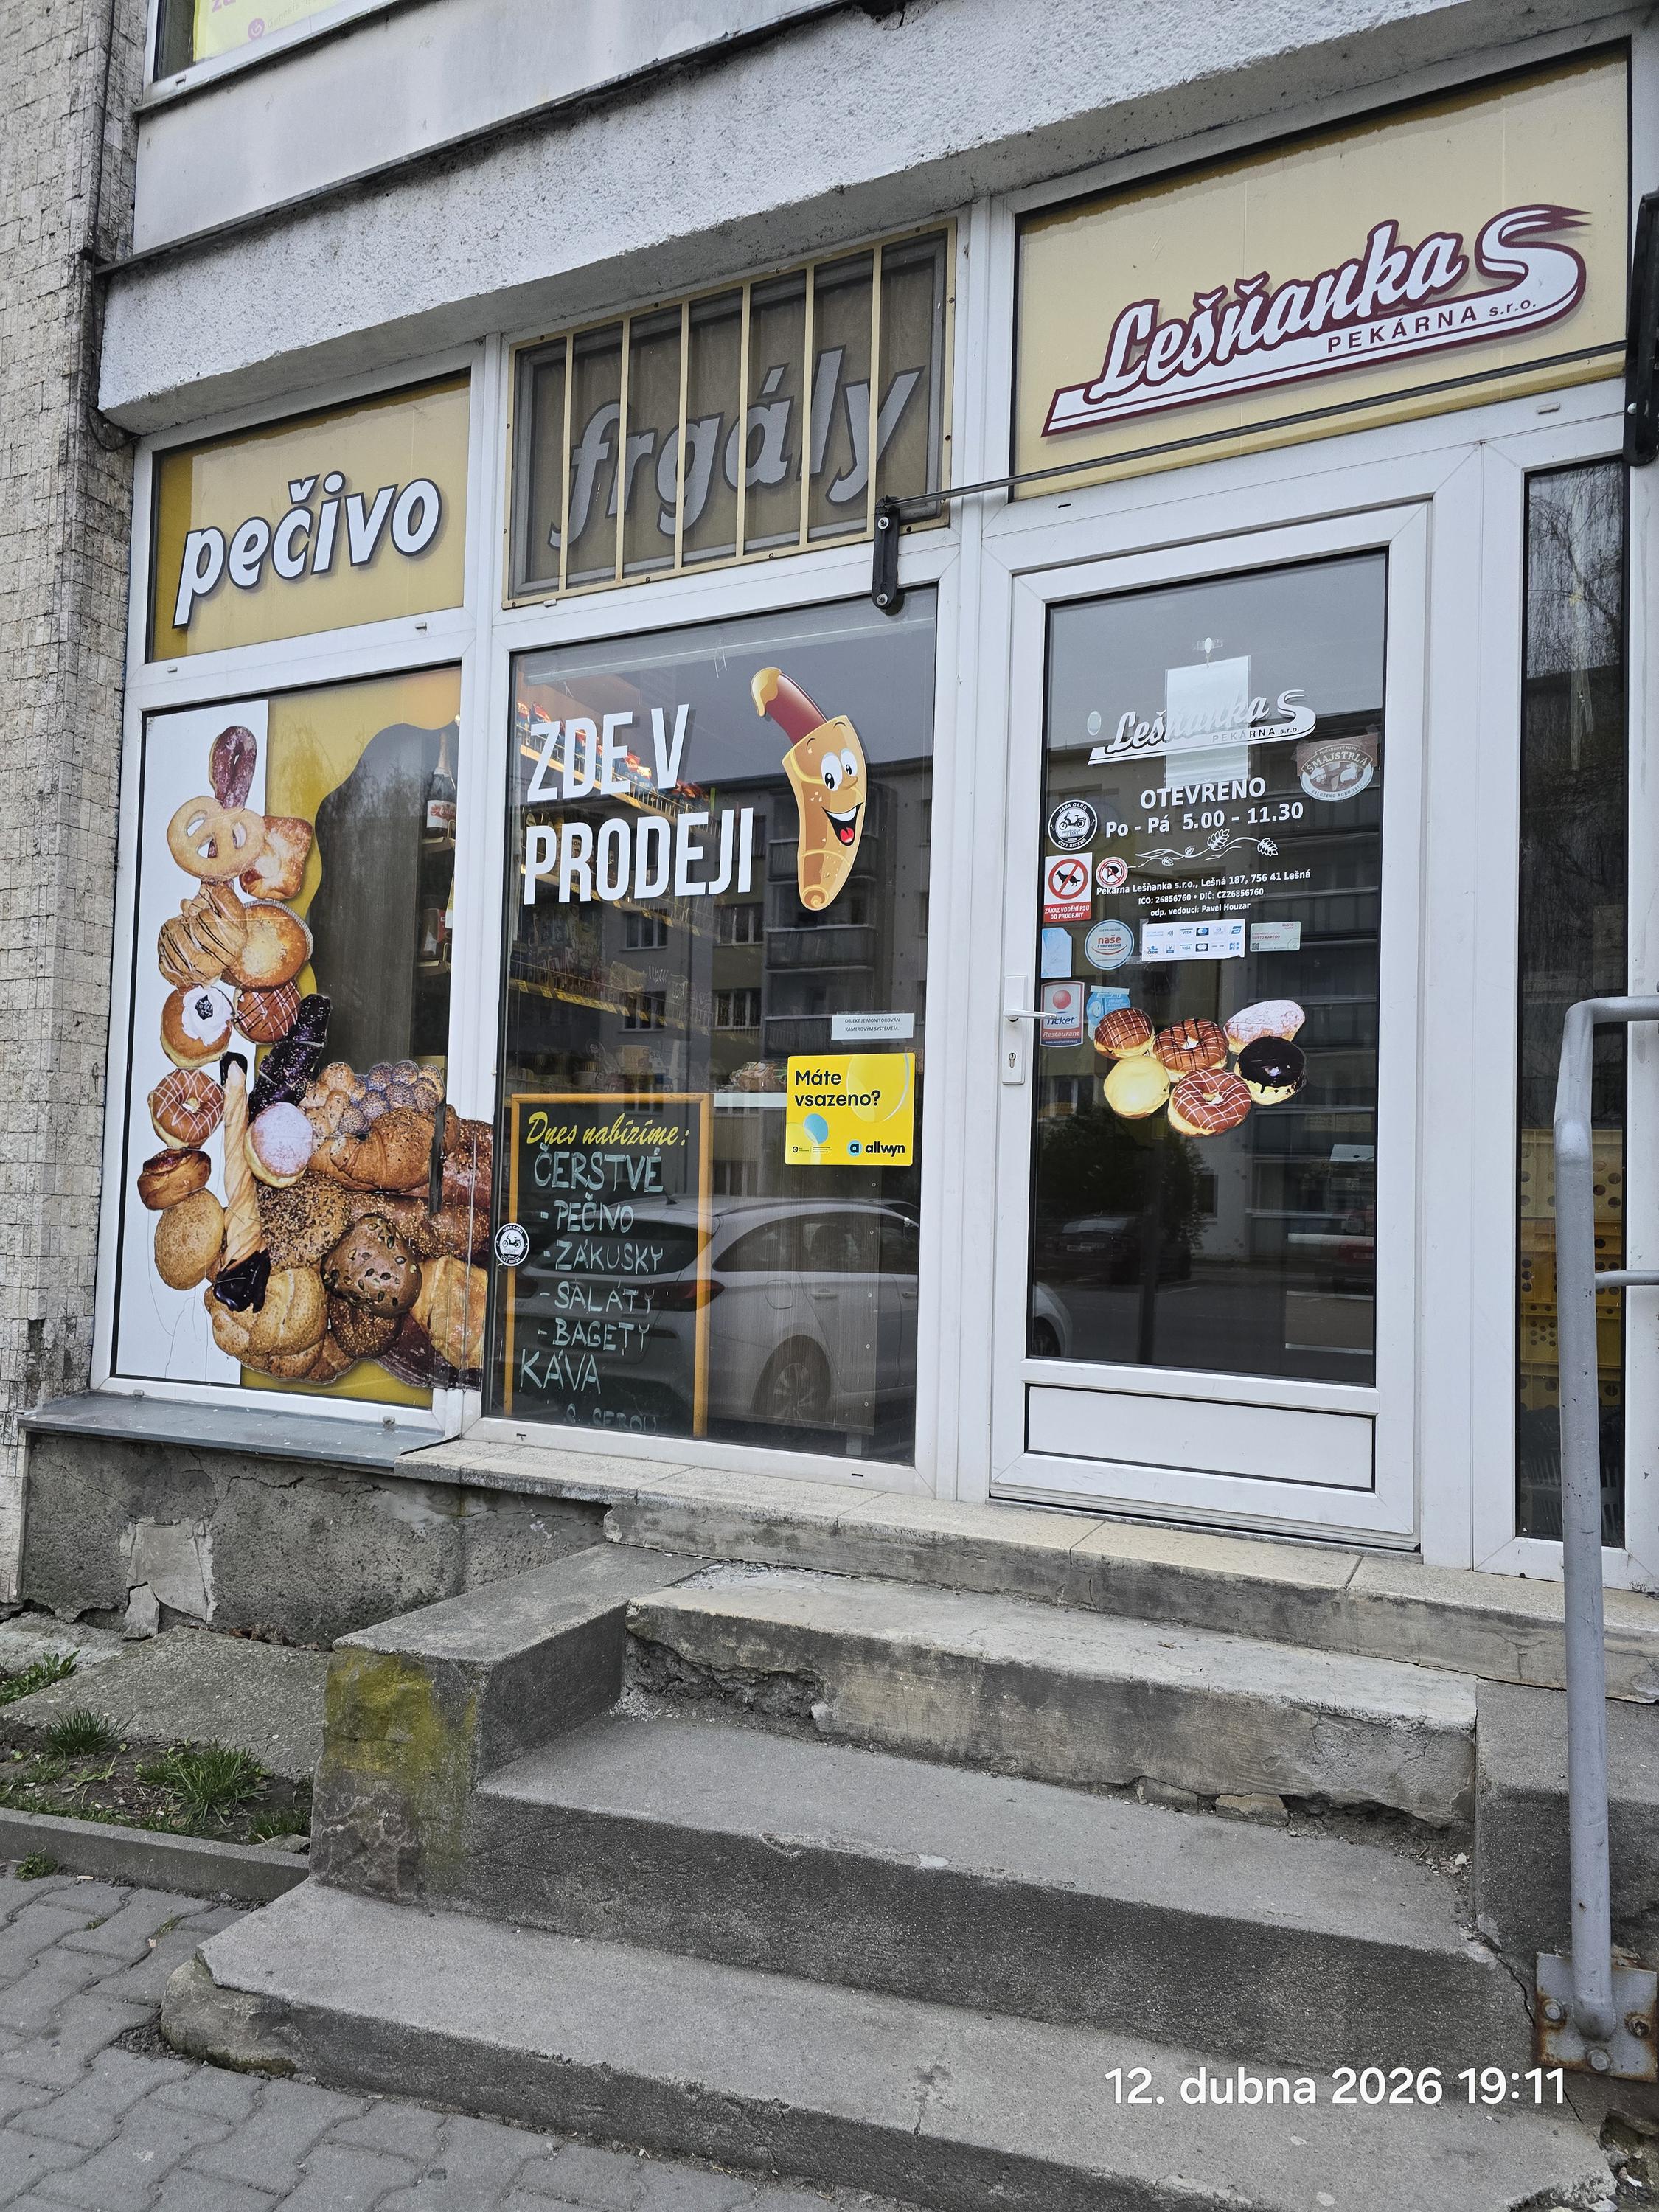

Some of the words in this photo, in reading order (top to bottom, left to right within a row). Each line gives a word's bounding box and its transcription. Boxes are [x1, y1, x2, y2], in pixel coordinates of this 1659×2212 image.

[1084, 219, 1469, 406] Lešňanka
[1327, 305, 1478, 355] PEKÁRNA
[1488, 299, 1538, 319] s.r.o.
[548, 345, 925, 551] frgály
[172, 470, 442, 629] pečivo
[1212, 727, 1276, 743] PEKÁRNA
[1280, 726, 1300, 734] s.r.o.
[527, 711, 633, 802] ZDE
[650, 704, 689, 790] V
[1305, 751, 1368, 772] ŠMAJSTRLA
[1140, 776, 1267, 810] OTEVŘENO
[1106, 821, 1129, 838] Po
[1148, 814, 1170, 834] Pá
[1183, 810, 1225, 831] 5.00
[1248, 801, 1304, 825] 11.30
[524, 807, 754, 905] PRODEJI
[1057, 839, 1068, 847] CITY
[1069, 838, 1087, 848] RIDERS
[1132, 880, 1172, 893] Lešňanka
[1201, 877, 1227, 888] Lešná
[1229, 875, 1248, 886] 187,
[1251, 873, 1267, 883] 756
[1270, 872, 1281, 882] 41
[1284, 869, 1311, 880] Lešná
[1138, 896, 1154, 905] IČO:
[1155, 893, 1192, 904] 26856760
[1199, 891, 1215, 901] DIČ:
[1217, 888, 1264, 900] CZ26856760
[1045, 905, 1060, 914] ZÁKAZ
[1060, 904, 1079, 914] VODĚNÍ
[1060, 911, 1084, 919] PRODEJNY
[1150, 909, 1167, 917] odp.
[1168, 905, 1200, 916] vedoucí:
[1201, 904, 1222, 914] Pavel
[1224, 902, 1251, 911] Houzar
[1098, 934, 1121, 945] naše
[795, 1070, 842, 1086] Máte
[794, 1090, 881, 1107] vsazeno?
[526, 1111, 577, 1144] Dnes
[865, 1141, 905, 1157] allwyn
[534, 1142, 664, 1192] ČERSTVÉ
[554, 1192, 635, 1233] PEČIVO
[555, 1239, 664, 1274] ZÁKUSKY
[554, 1279, 655, 1314] SALÁTY
[553, 1317, 650, 1353] BAGETY
[520, 1349, 602, 1395] KÁVA
